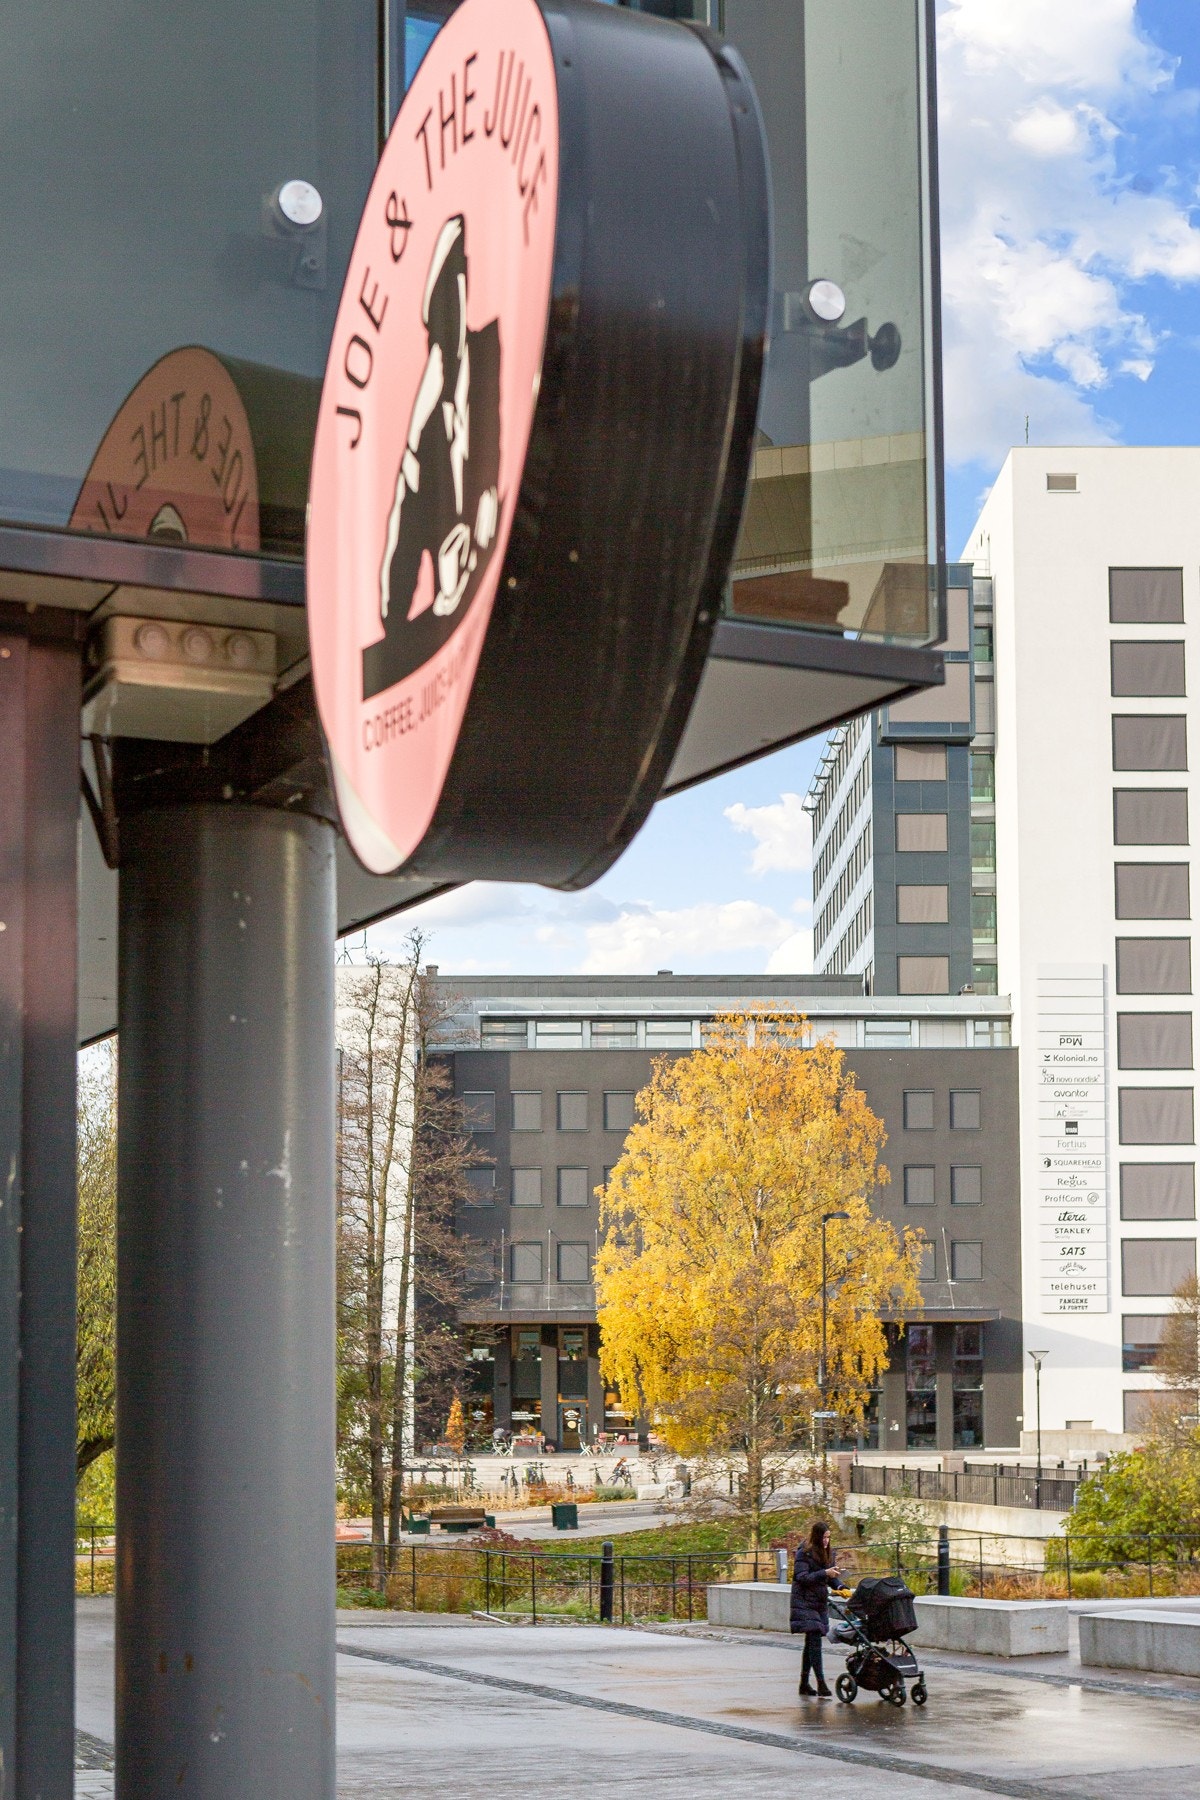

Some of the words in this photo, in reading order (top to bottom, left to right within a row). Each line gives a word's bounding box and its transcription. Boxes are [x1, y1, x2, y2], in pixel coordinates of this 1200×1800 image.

[336, 266, 389, 450] JOE
[386, 190, 413, 263] &
[415, 51, 478, 192] THE
[1053, 1054, 1098, 1062] Kolonial.no
[1053, 1089, 1089, 1097] avantor
[1057, 1139, 1087, 1148] Fortius
[1057, 1177, 1088, 1187] Regus
[1044, 1194, 1083, 1202] ProffCom
[1058, 1211, 1088, 1222] itera
[1060, 1246, 1087, 1256] SATS
[1051, 1282, 1096, 1291] telehuset
